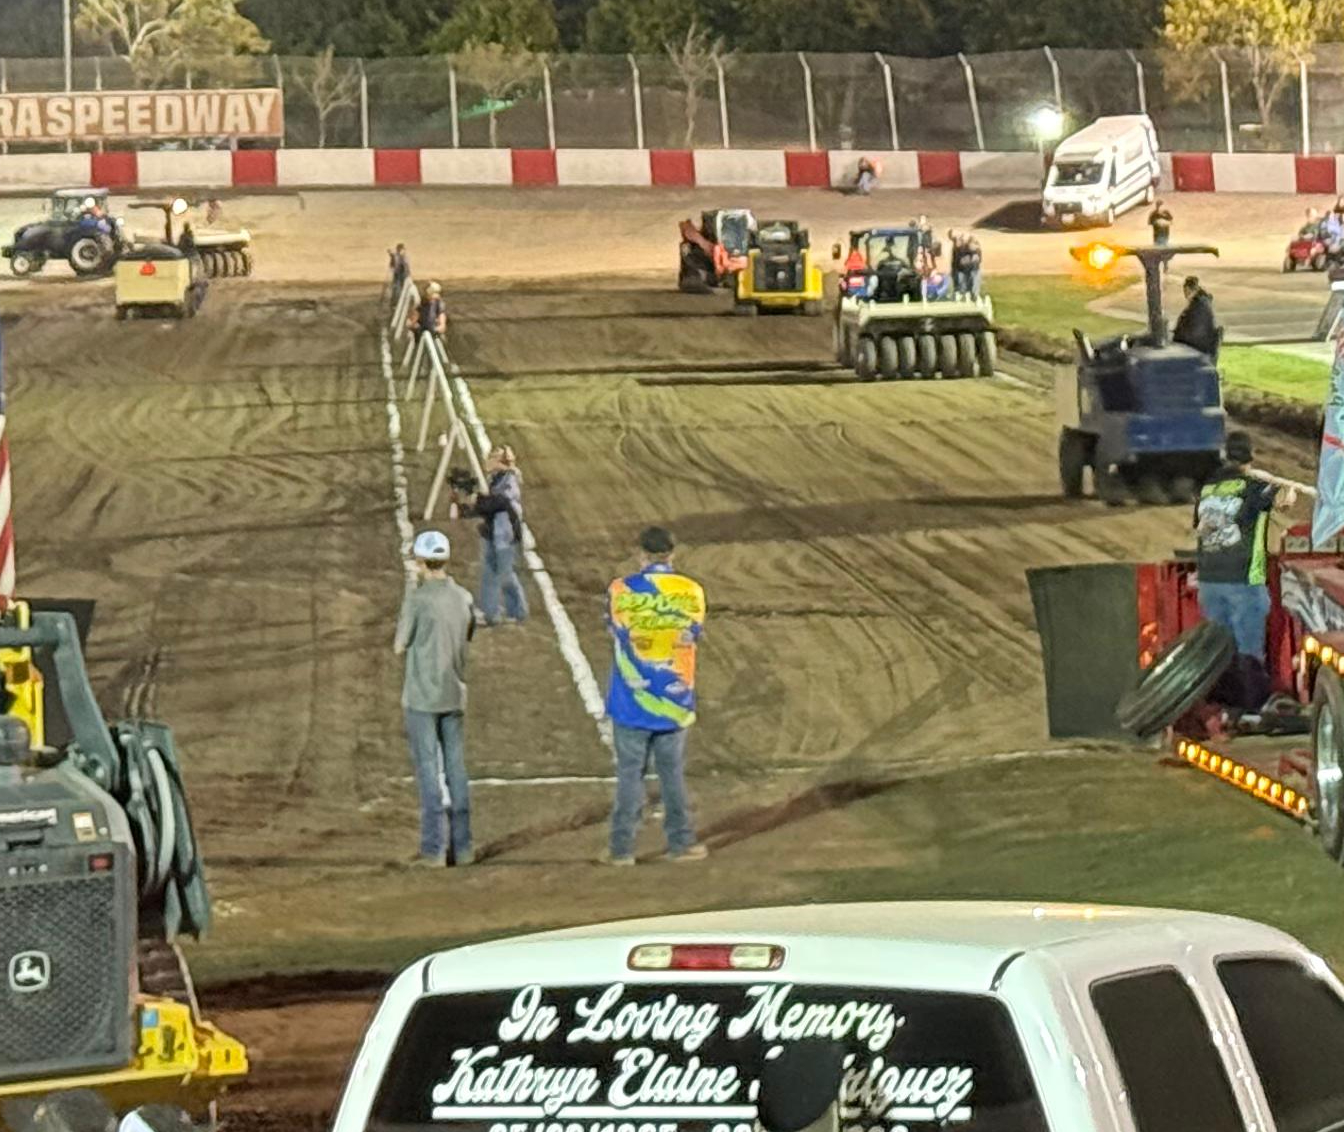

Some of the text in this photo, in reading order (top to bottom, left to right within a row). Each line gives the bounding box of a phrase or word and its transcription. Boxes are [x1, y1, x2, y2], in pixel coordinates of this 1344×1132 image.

[45, 93, 278, 136] SPEEDWAY
[498, 983, 560, 1042] In
[567, 982, 720, 1052] Loving
[432, 1046, 600, 1115] Kathryn
[609, 1045, 741, 1108] Elaine
